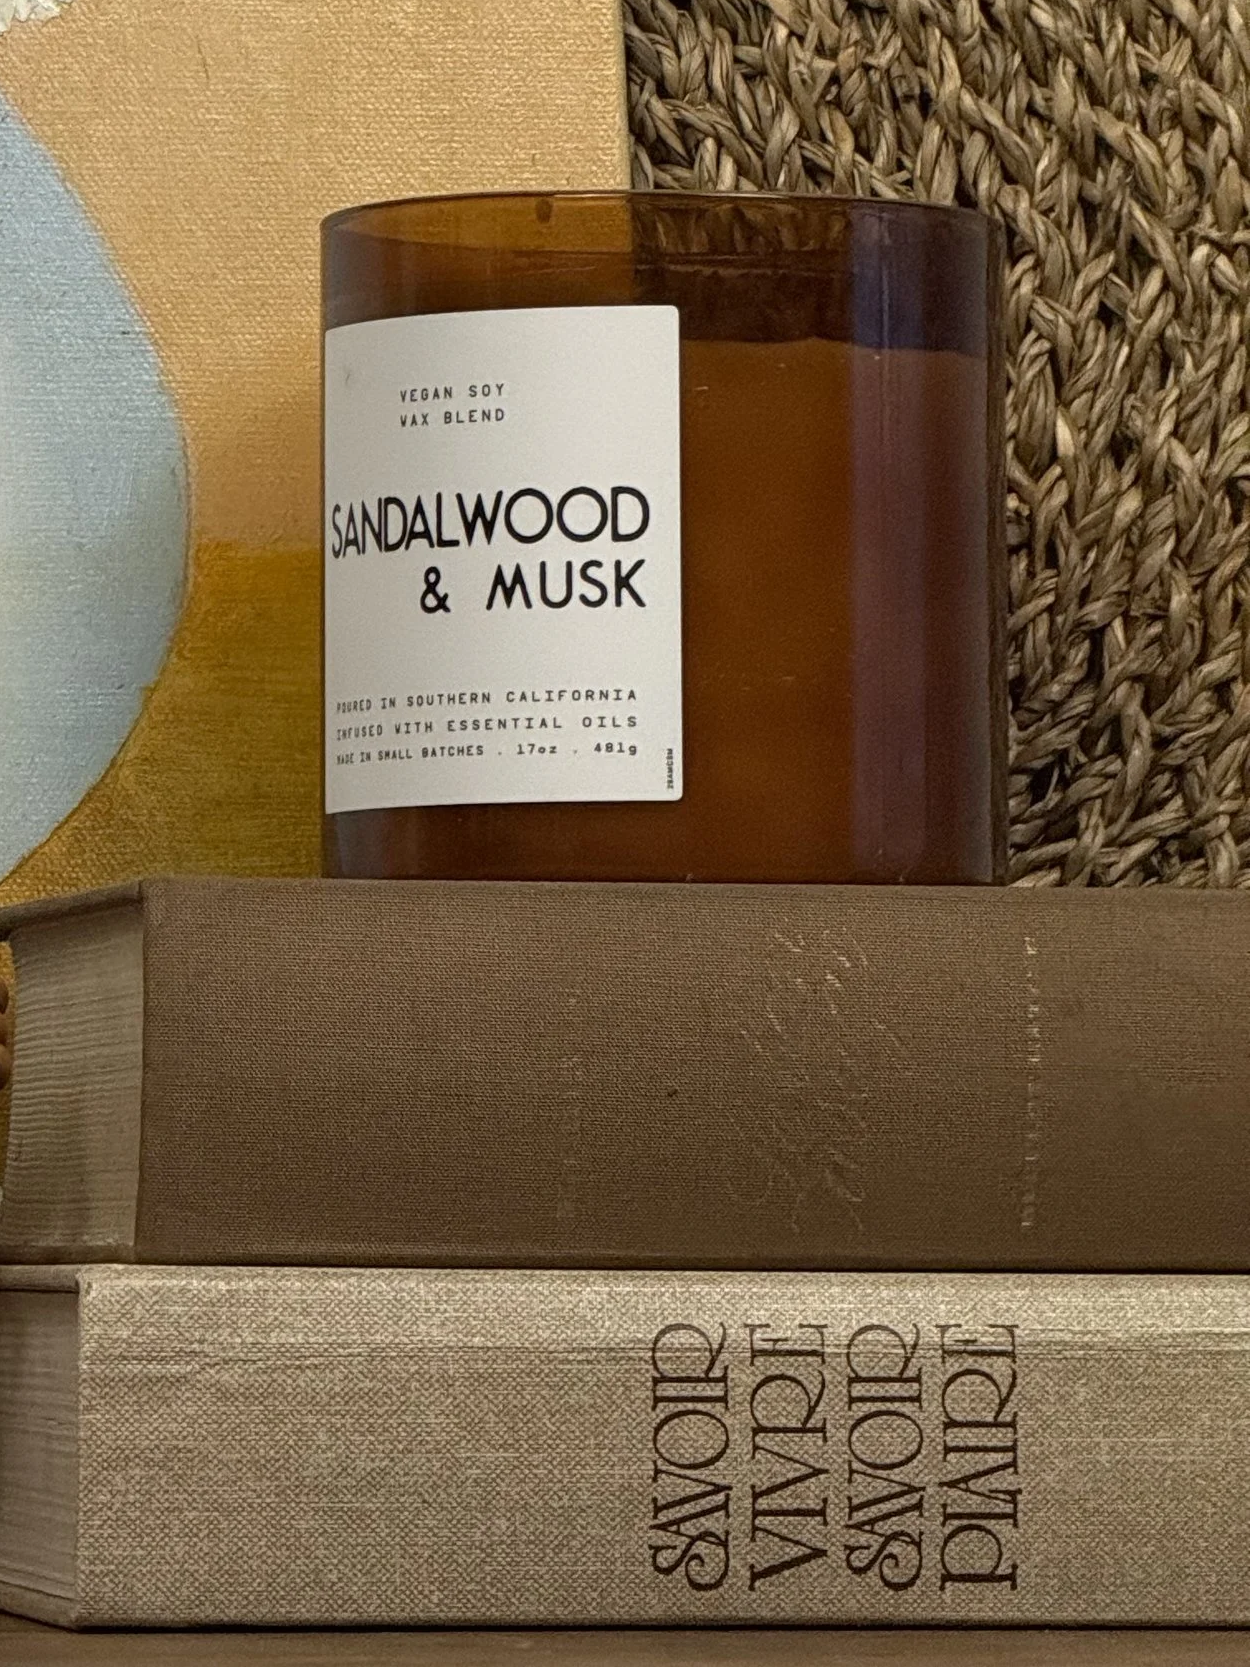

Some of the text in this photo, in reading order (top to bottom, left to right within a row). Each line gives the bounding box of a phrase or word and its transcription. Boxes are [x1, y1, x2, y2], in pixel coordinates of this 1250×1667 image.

[399, 382, 505, 403] VEGAN SOY
[443, 407, 505, 425] BLEND
[331, 485, 650, 561] SANDALWOOD
[419, 558, 647, 615] & MUSK
[380, 697, 396, 710] IN
[406, 692, 491, 708] SOUTHERN
[505, 688, 637, 703] CALIFORNIA
[446, 716, 562, 733] ESSENTIAL
[581, 715, 637, 729] OILS
[360, 751, 372, 763] IN
[377, 749, 413, 762] SMALL
[421, 744, 484, 759] BATCHES
[649, 1321, 733, 1592] SAVOIR
[744, 1322, 830, 1592] VIVRE
[844, 1321, 926, 1592] SAVOIR
[935, 1323, 1022, 1591] PLAIRE
